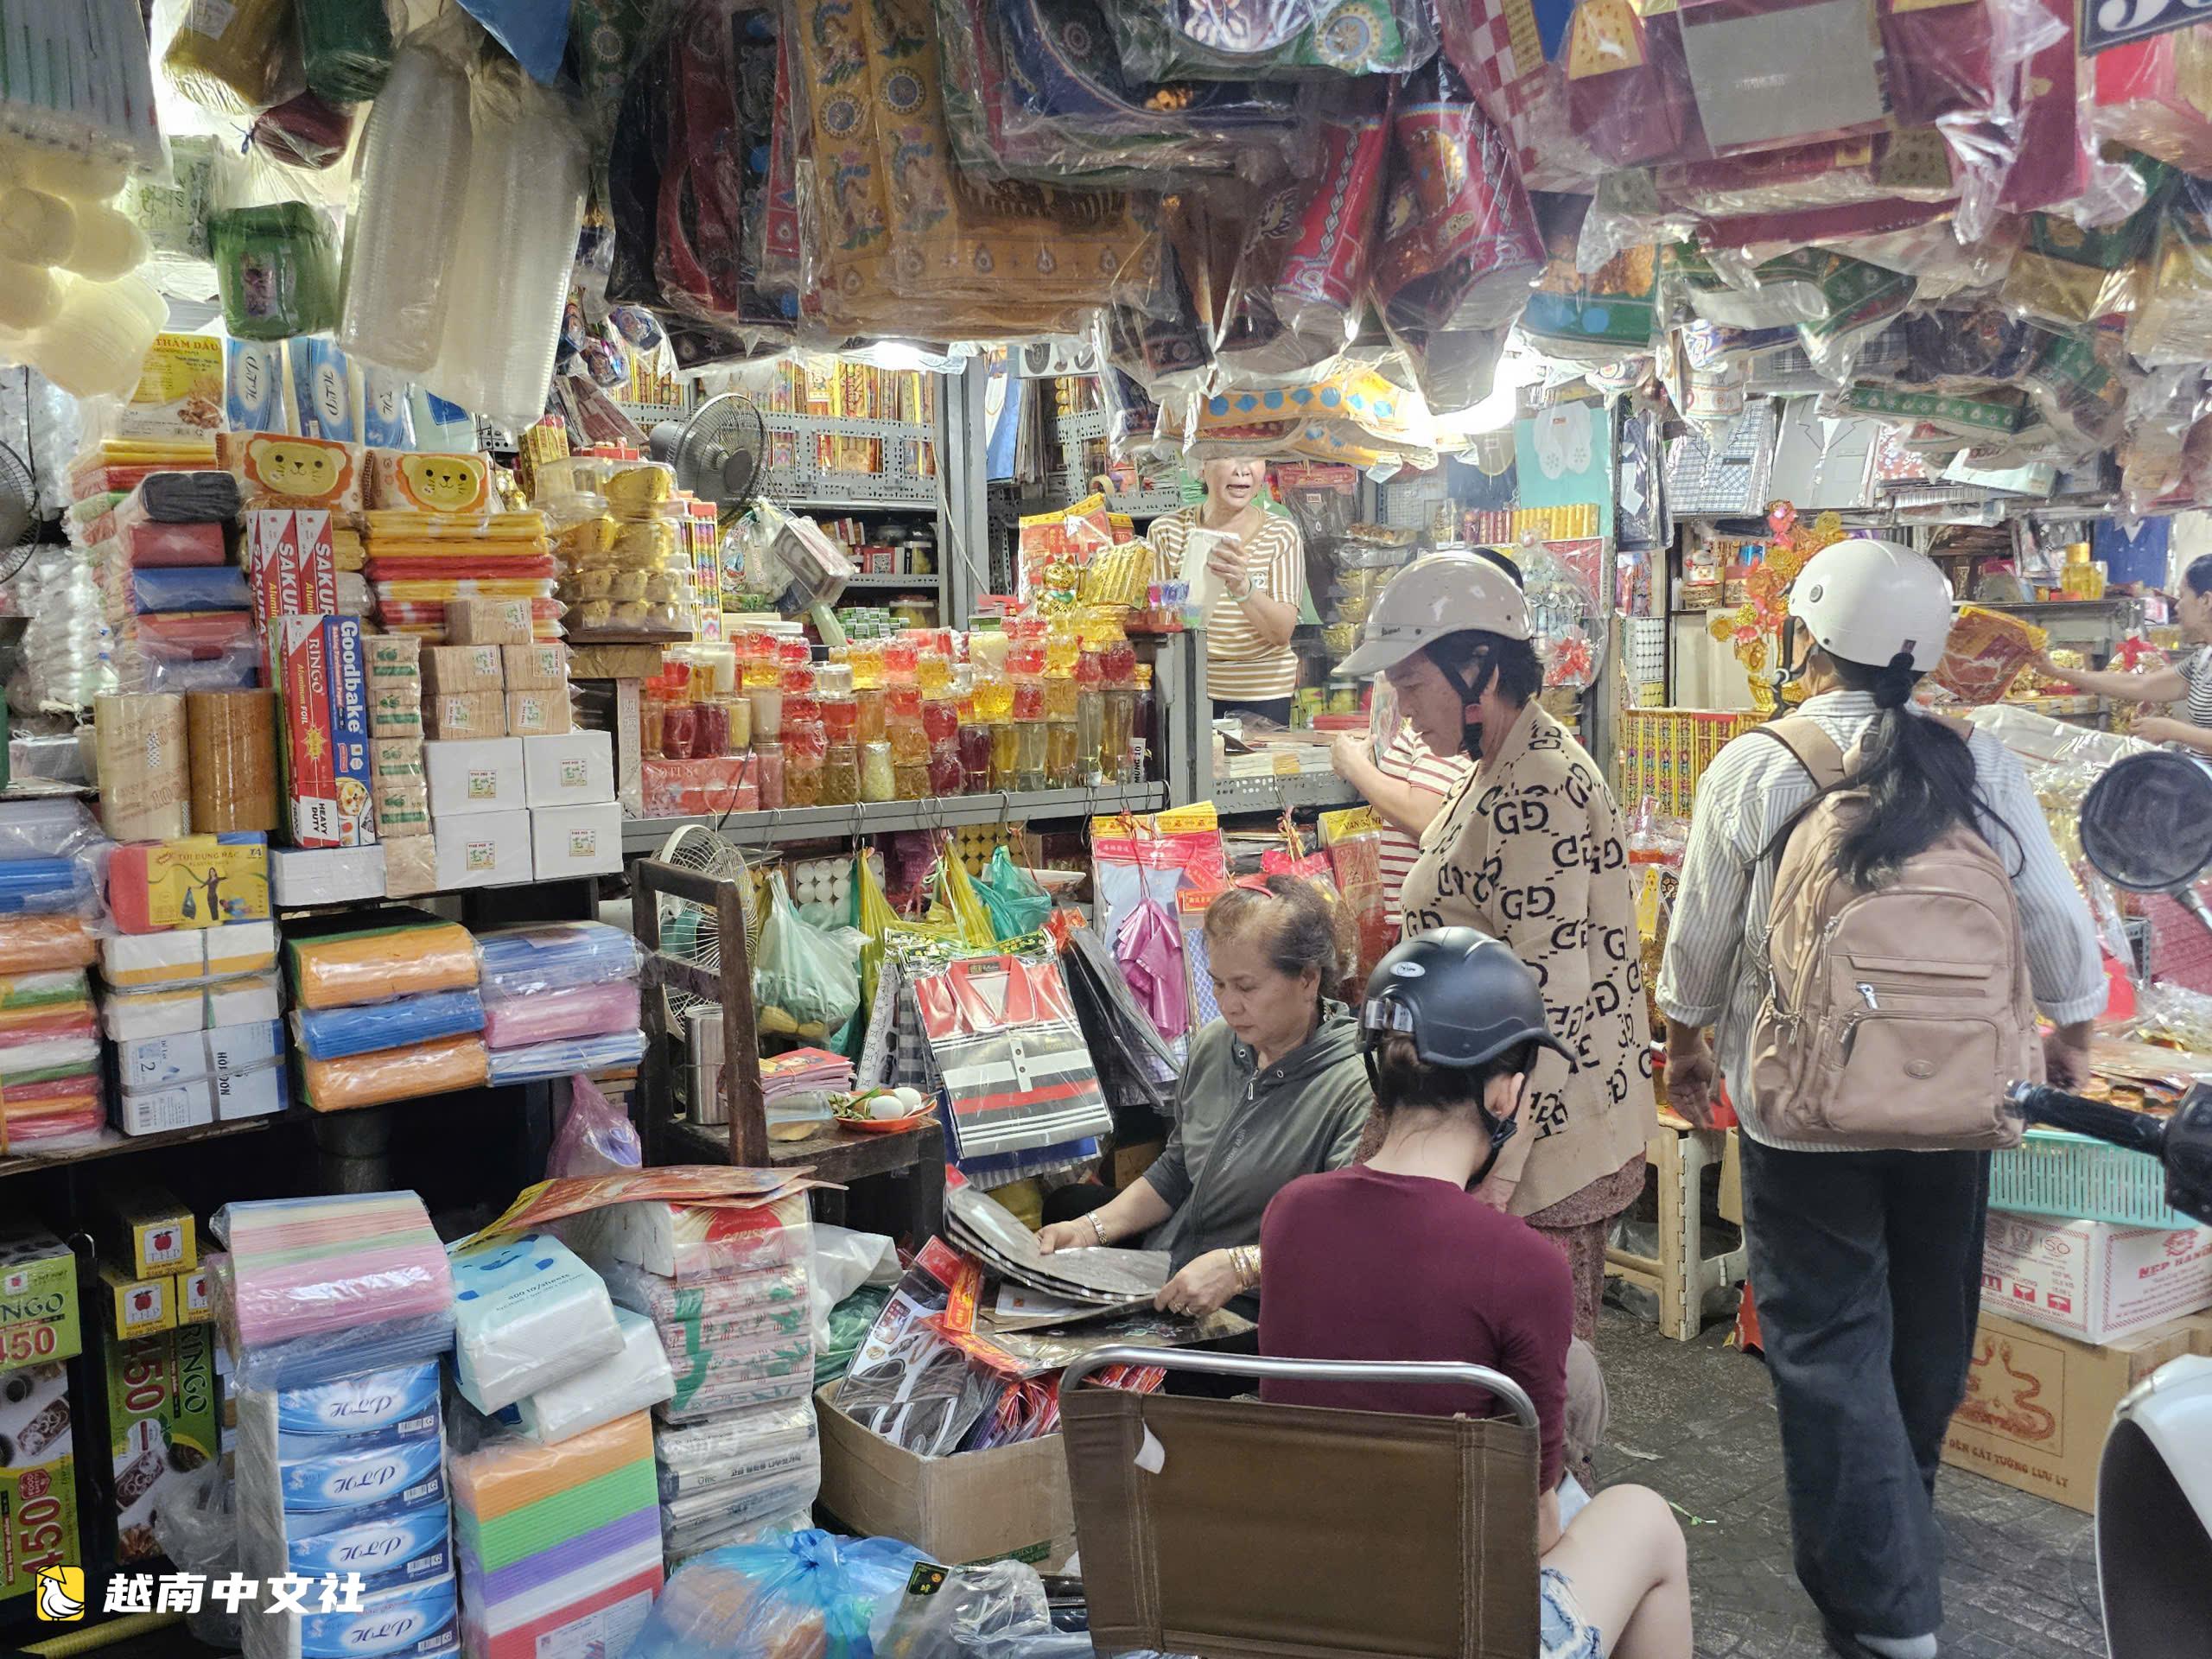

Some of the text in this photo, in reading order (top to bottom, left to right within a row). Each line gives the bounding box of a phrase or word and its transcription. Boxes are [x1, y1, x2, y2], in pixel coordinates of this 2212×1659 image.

[278, 541, 299, 615] SAKUR
[314, 541, 335, 615] SAKUR
[308, 638, 324, 694] RINGO
[340, 620, 363, 734] Goodbake
[300, 705, 308, 725] FOIL
[310, 806, 320, 832] DUTY
[318, 803, 327, 835] HEAVY
